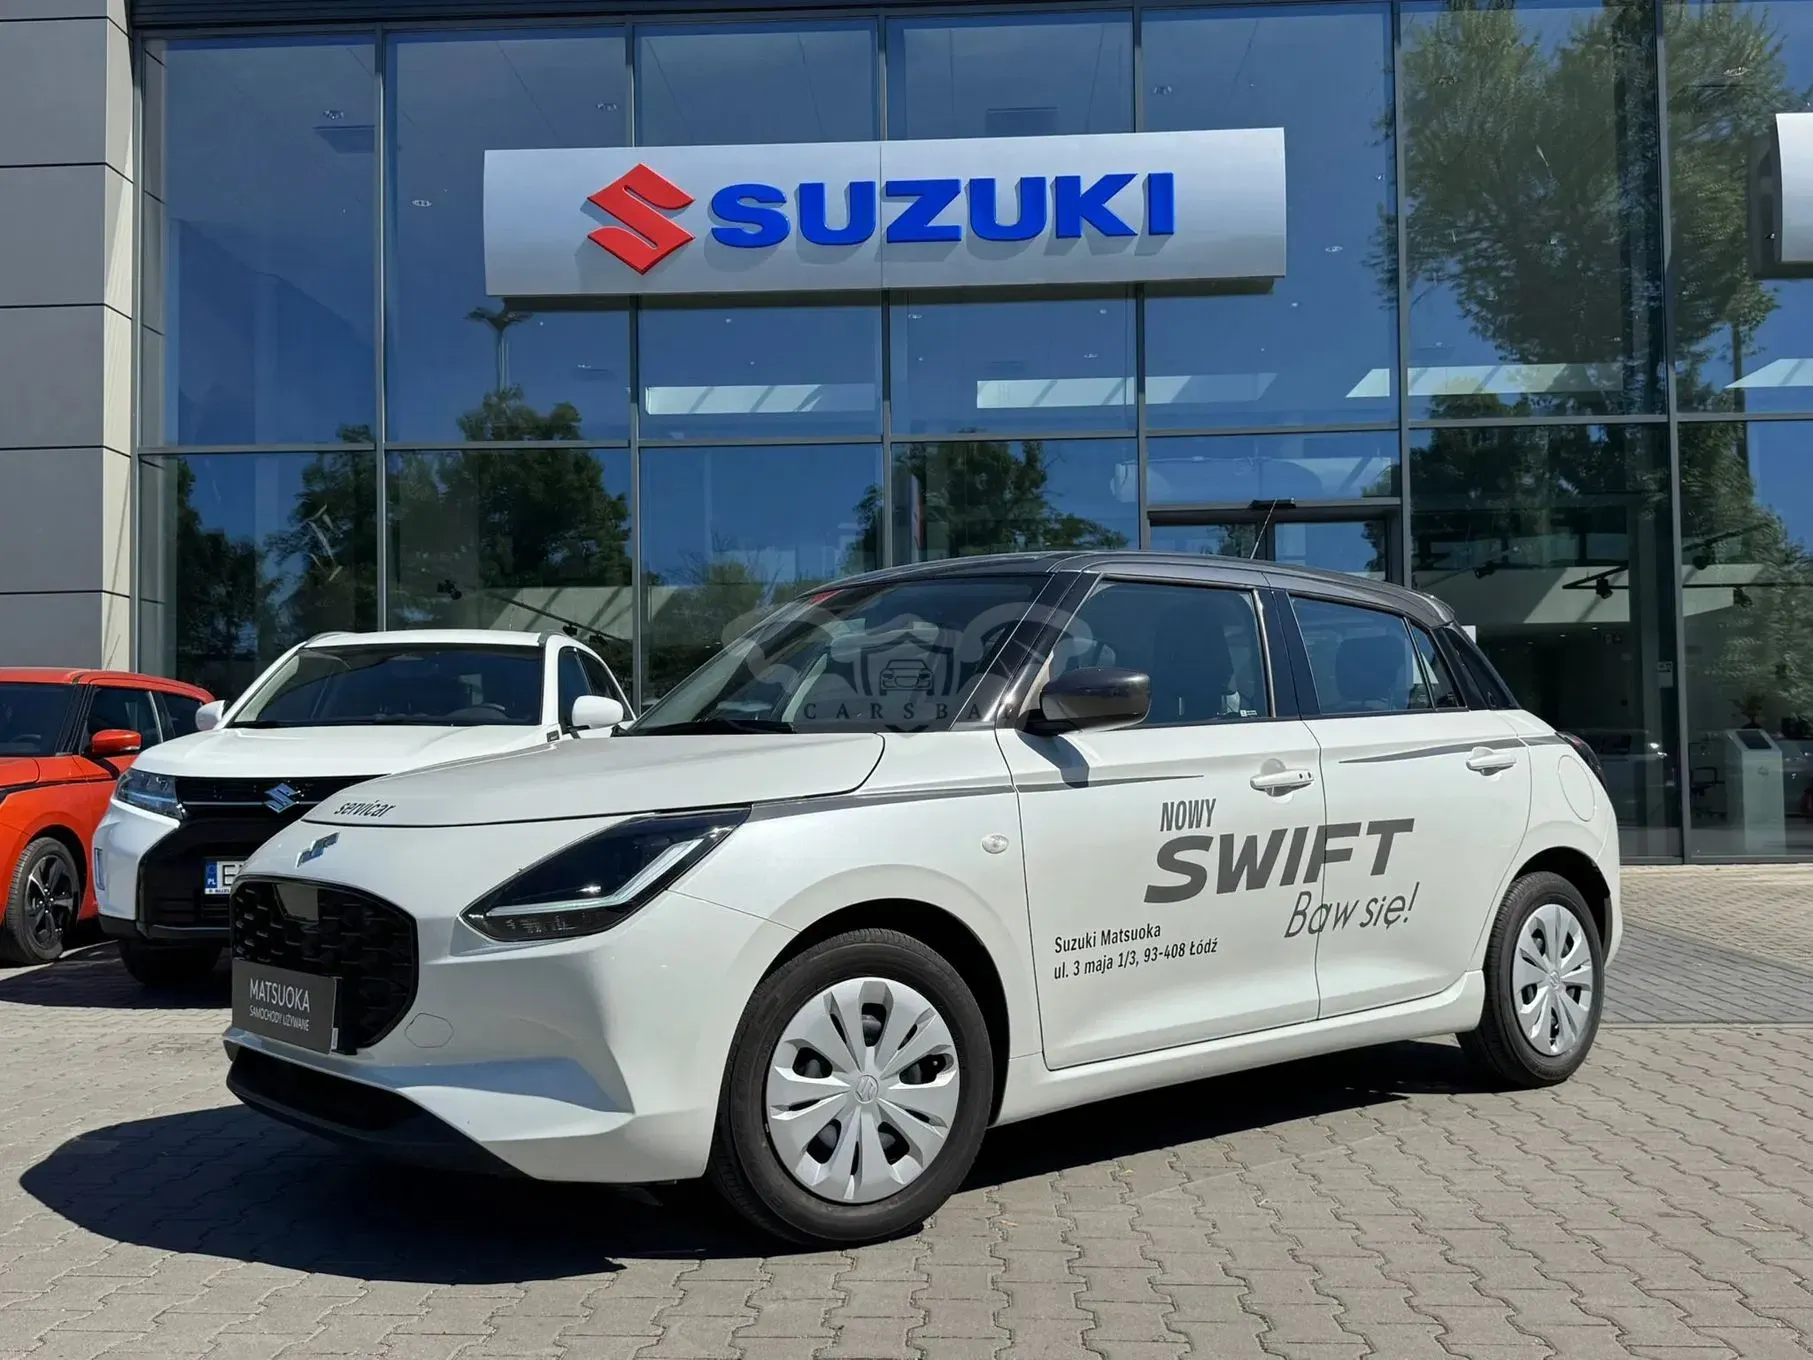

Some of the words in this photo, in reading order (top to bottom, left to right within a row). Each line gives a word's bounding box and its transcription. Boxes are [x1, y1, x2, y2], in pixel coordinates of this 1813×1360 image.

[710, 172, 1175, 249] SUZUKI
[333, 800, 397, 818] servicar
[1159, 798, 1217, 832] NOWY
[1143, 818, 1415, 903] SWIFT
[1283, 890, 1360, 939] Baw
[1359, 881, 1420, 930] się!
[1054, 931, 1097, 954] Suzuki
[1100, 923, 1161, 946] Matsuoka
[1054, 961, 1069, 980] ul.
[1073, 960, 1080, 977] 3
[1084, 954, 1113, 975] maja
[1117, 950, 1140, 969] 1/3,
[1143, 942, 1186, 963] 93-408
[1189, 937, 1218, 956] Łódź
[249, 978, 310, 1013] MATSUOKA
[249, 1004, 282, 1024] SAMOCHODY
